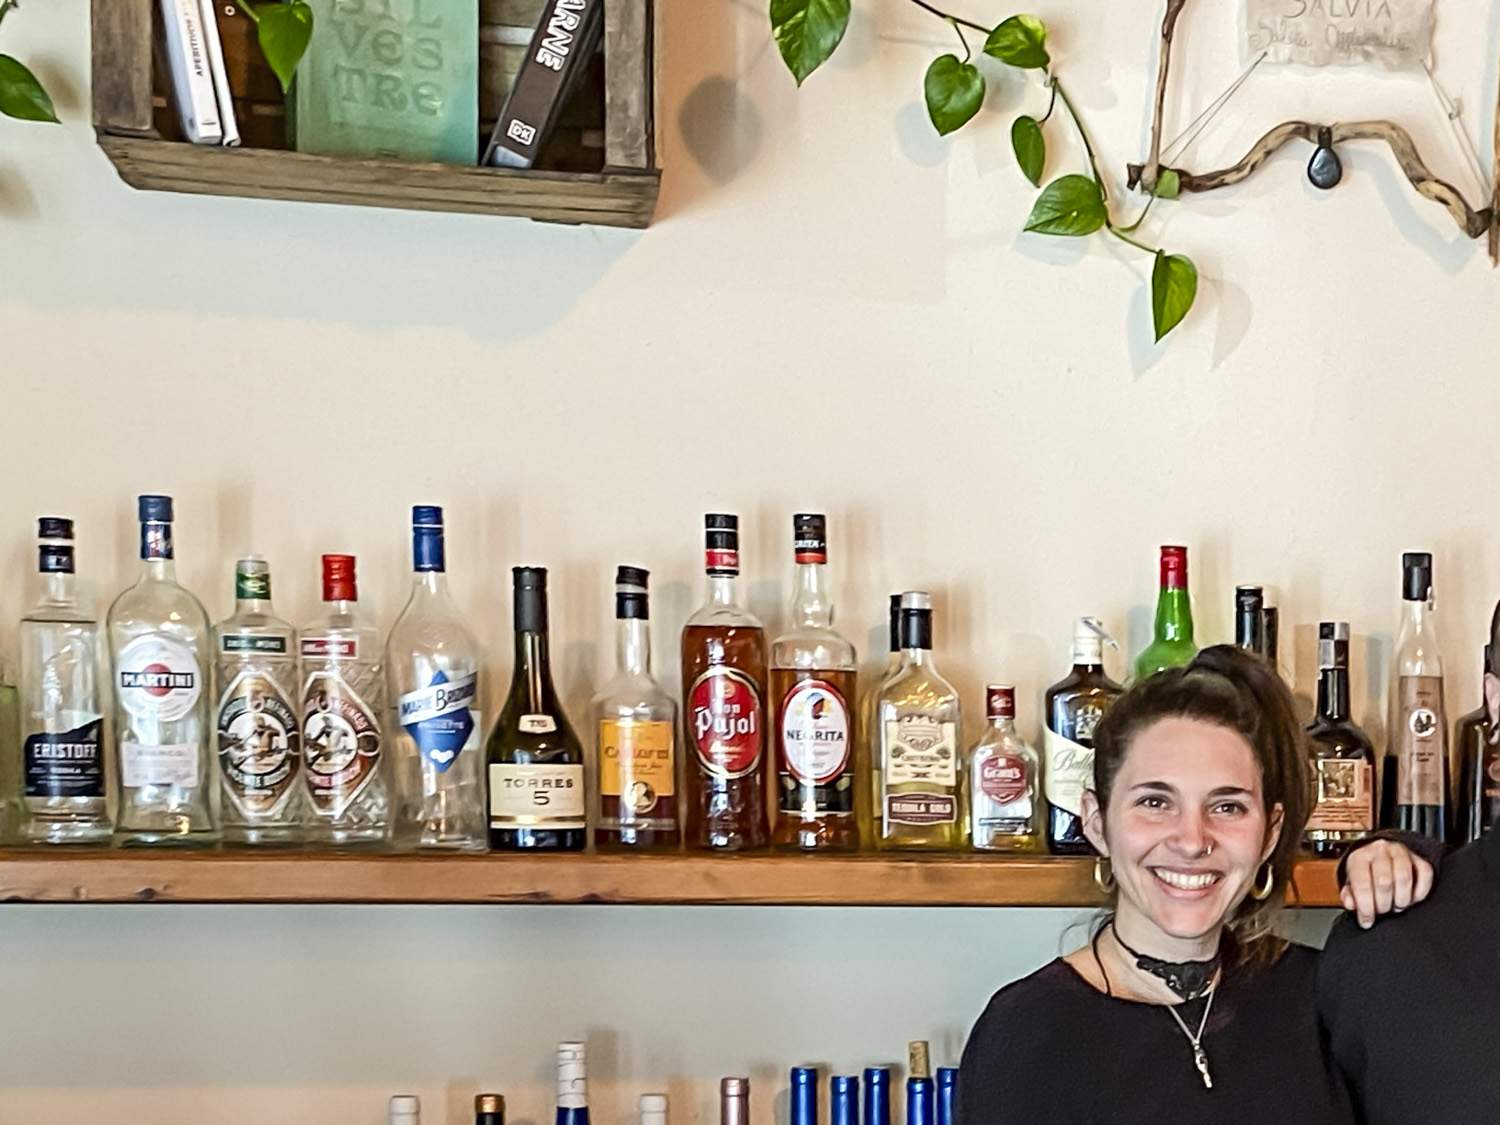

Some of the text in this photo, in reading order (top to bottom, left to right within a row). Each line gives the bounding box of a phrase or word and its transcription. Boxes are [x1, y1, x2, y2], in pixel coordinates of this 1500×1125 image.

[122, 673, 193, 688] MARTINI
[695, 706, 755, 740] Pujol
[34, 744, 97, 758] ERISTOFF
[504, 779, 574, 788] TORRES
[533, 790, 550, 805] 5
